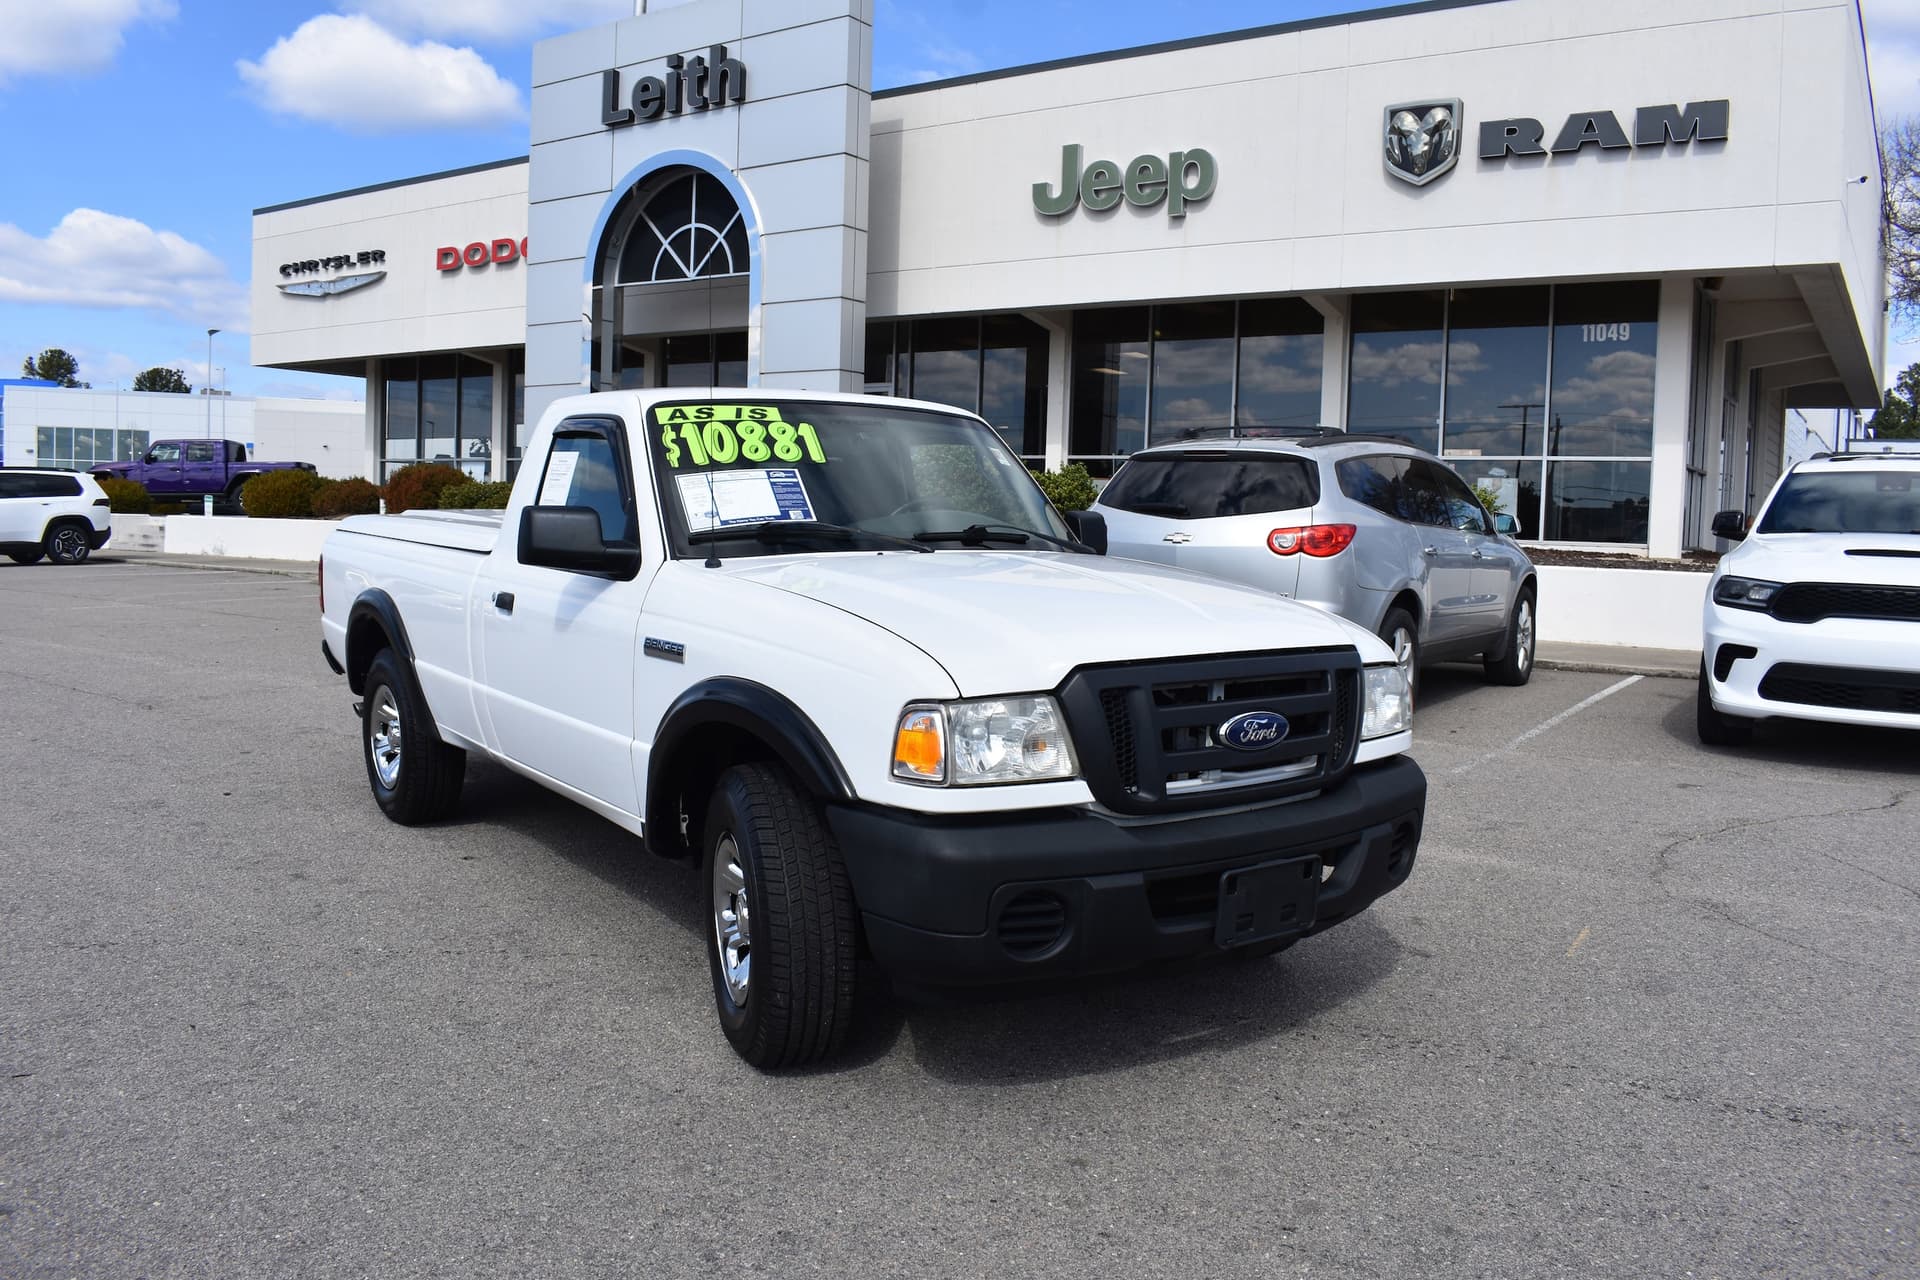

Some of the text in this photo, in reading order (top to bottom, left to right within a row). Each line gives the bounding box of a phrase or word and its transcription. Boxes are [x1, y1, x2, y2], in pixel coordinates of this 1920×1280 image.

[602, 44, 747, 127] Leith
[1478, 98, 1730, 160] RAM
[1032, 143, 1219, 219] Jeep
[279, 249, 386, 277] CHRYSLER
[436, 238, 528, 271] DOD
[1582, 323, 1630, 342] 11049
[667, 407, 768, 422] AS IS
[662, 420, 827, 468] $10881
[1240, 719, 1277, 743] Ford
